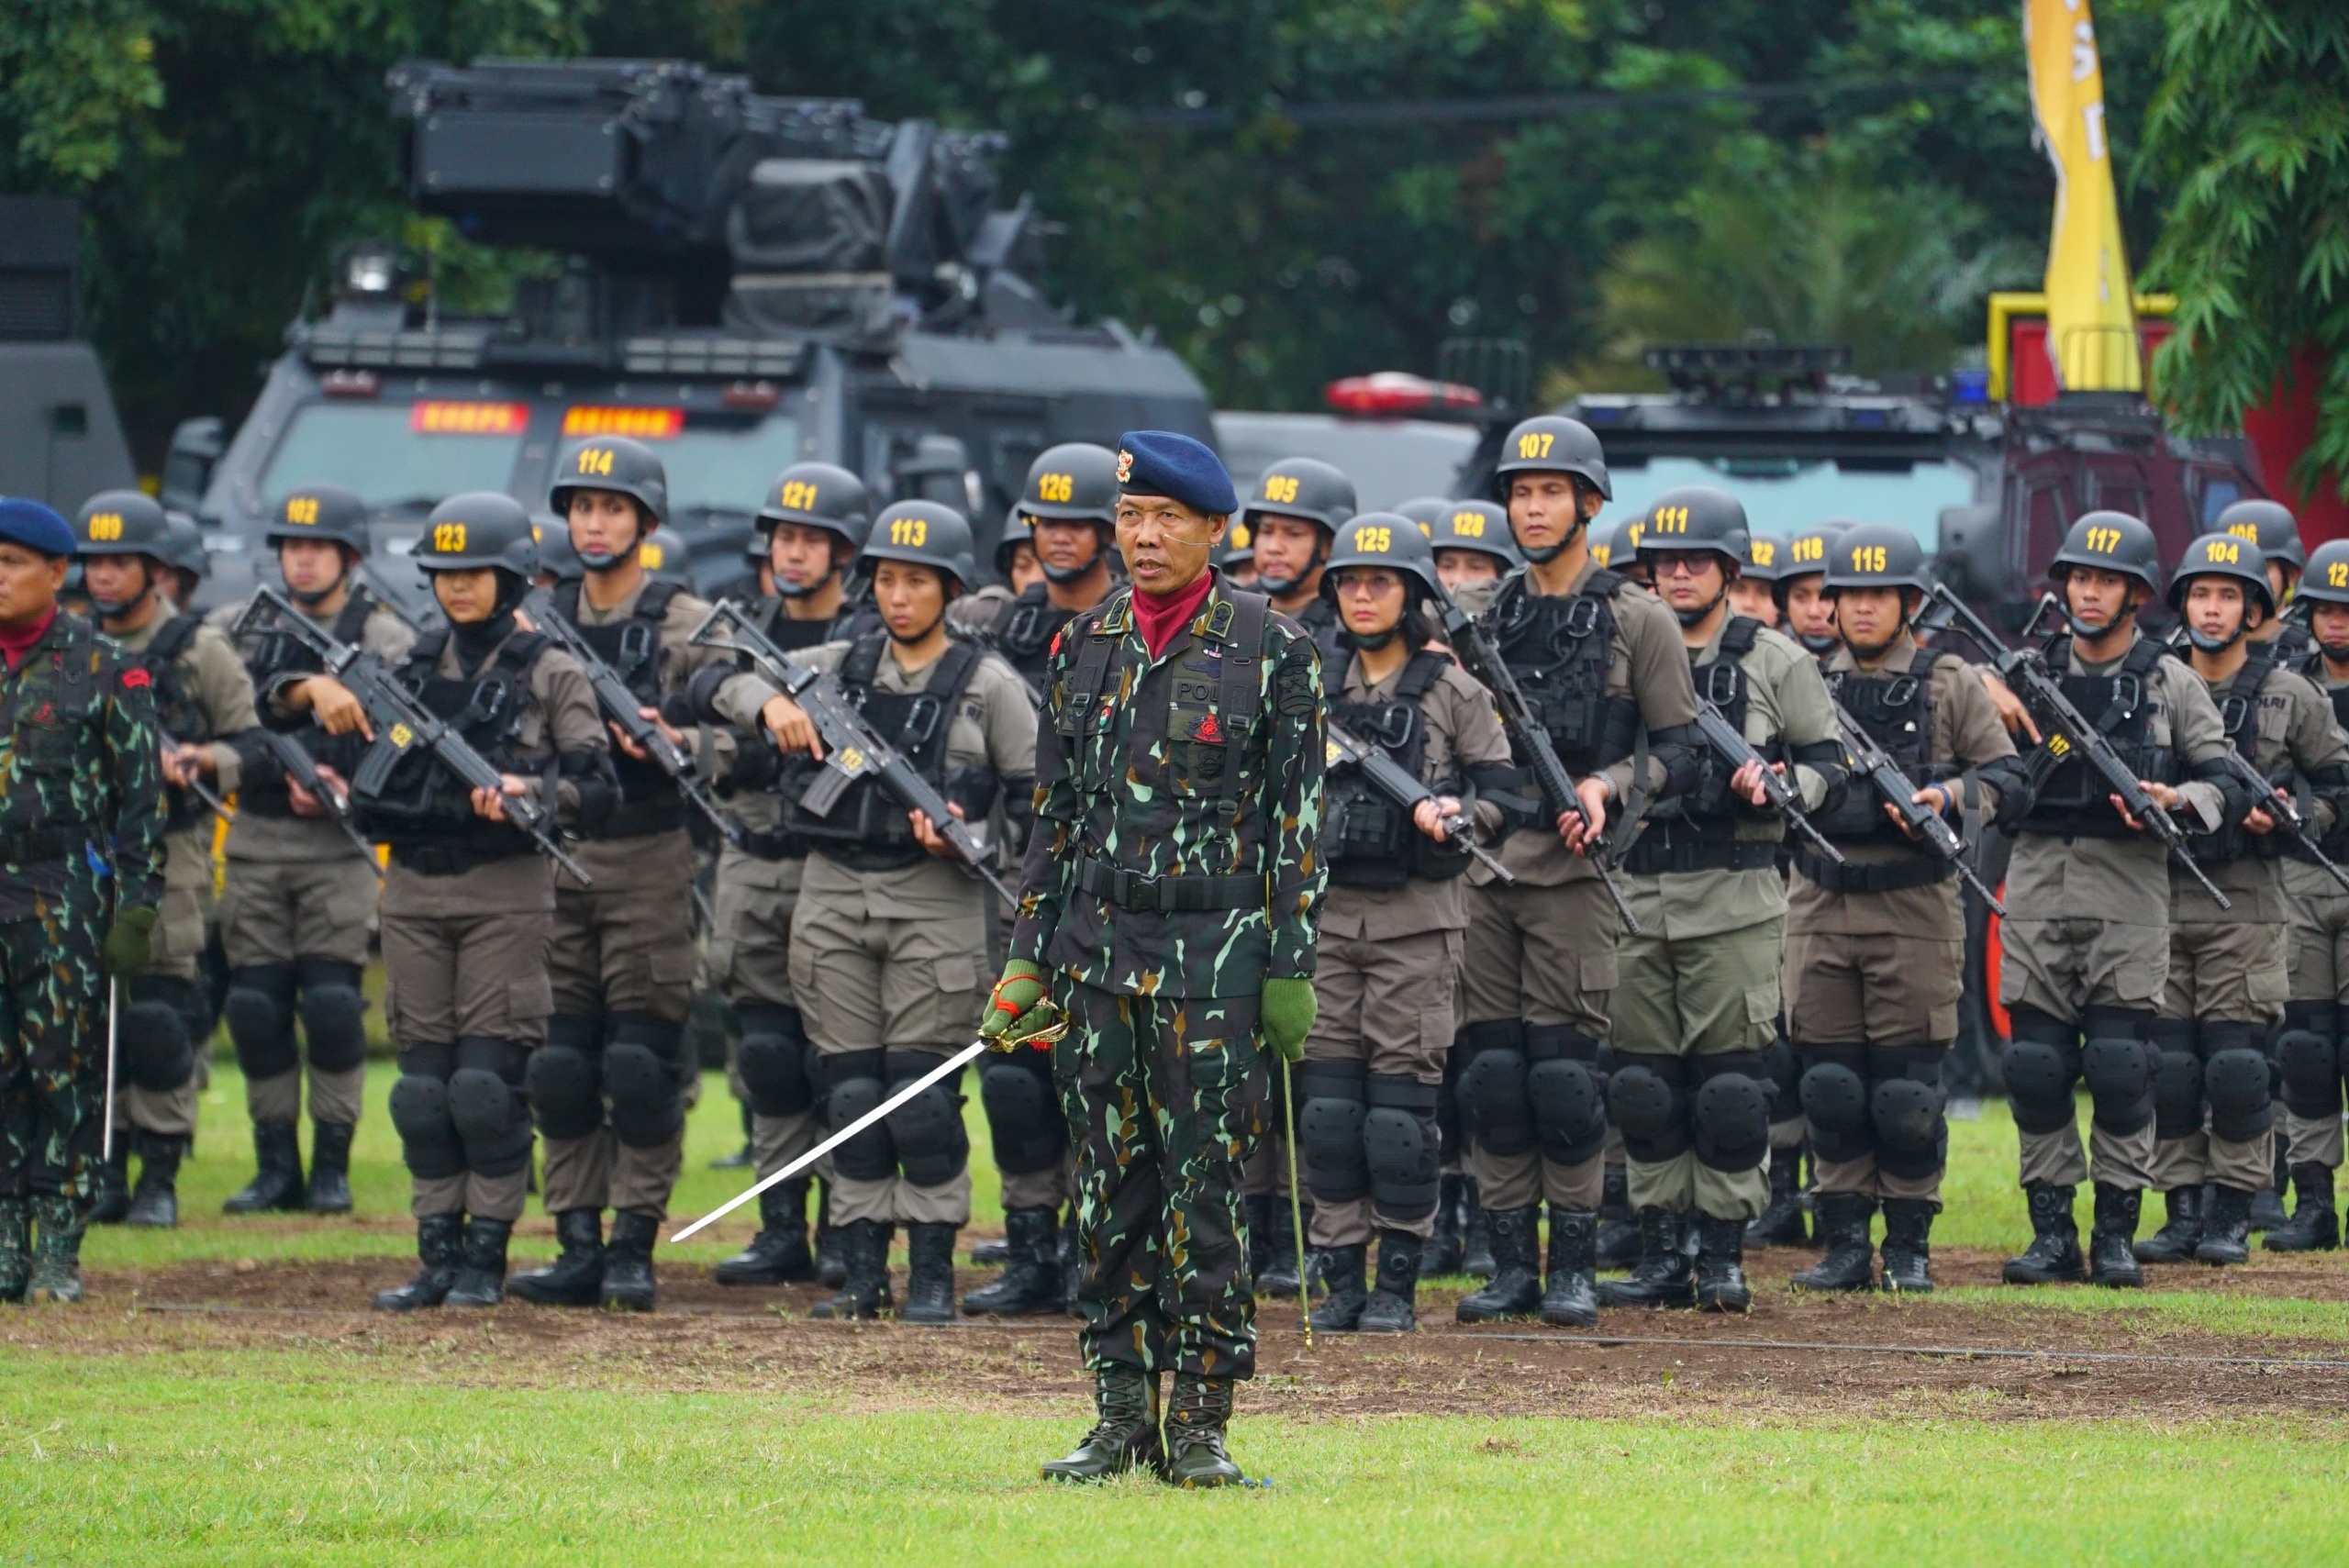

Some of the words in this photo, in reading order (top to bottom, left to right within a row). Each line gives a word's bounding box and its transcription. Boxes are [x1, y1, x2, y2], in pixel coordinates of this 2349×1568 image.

[1519, 434, 1553, 459] 107
[578, 450, 612, 476] 114
[781, 482, 816, 510] 121
[1039, 473, 1073, 504] 126
[1265, 477, 1297, 504] 105
[891, 520, 926, 547] 113
[1453, 512, 1486, 538] 128
[1655, 508, 1687, 533] 111
[432, 522, 466, 553] 123
[1354, 526, 1388, 552] 125
[1791, 537, 1822, 562] 118
[2087, 526, 2121, 554] 117
[1851, 547, 1886, 573] 115
[2207, 540, 2239, 565] 104
[2327, 560, 2349, 588] 12
[1177, 682, 1219, 703] POL
[2047, 733, 2071, 757] 117
